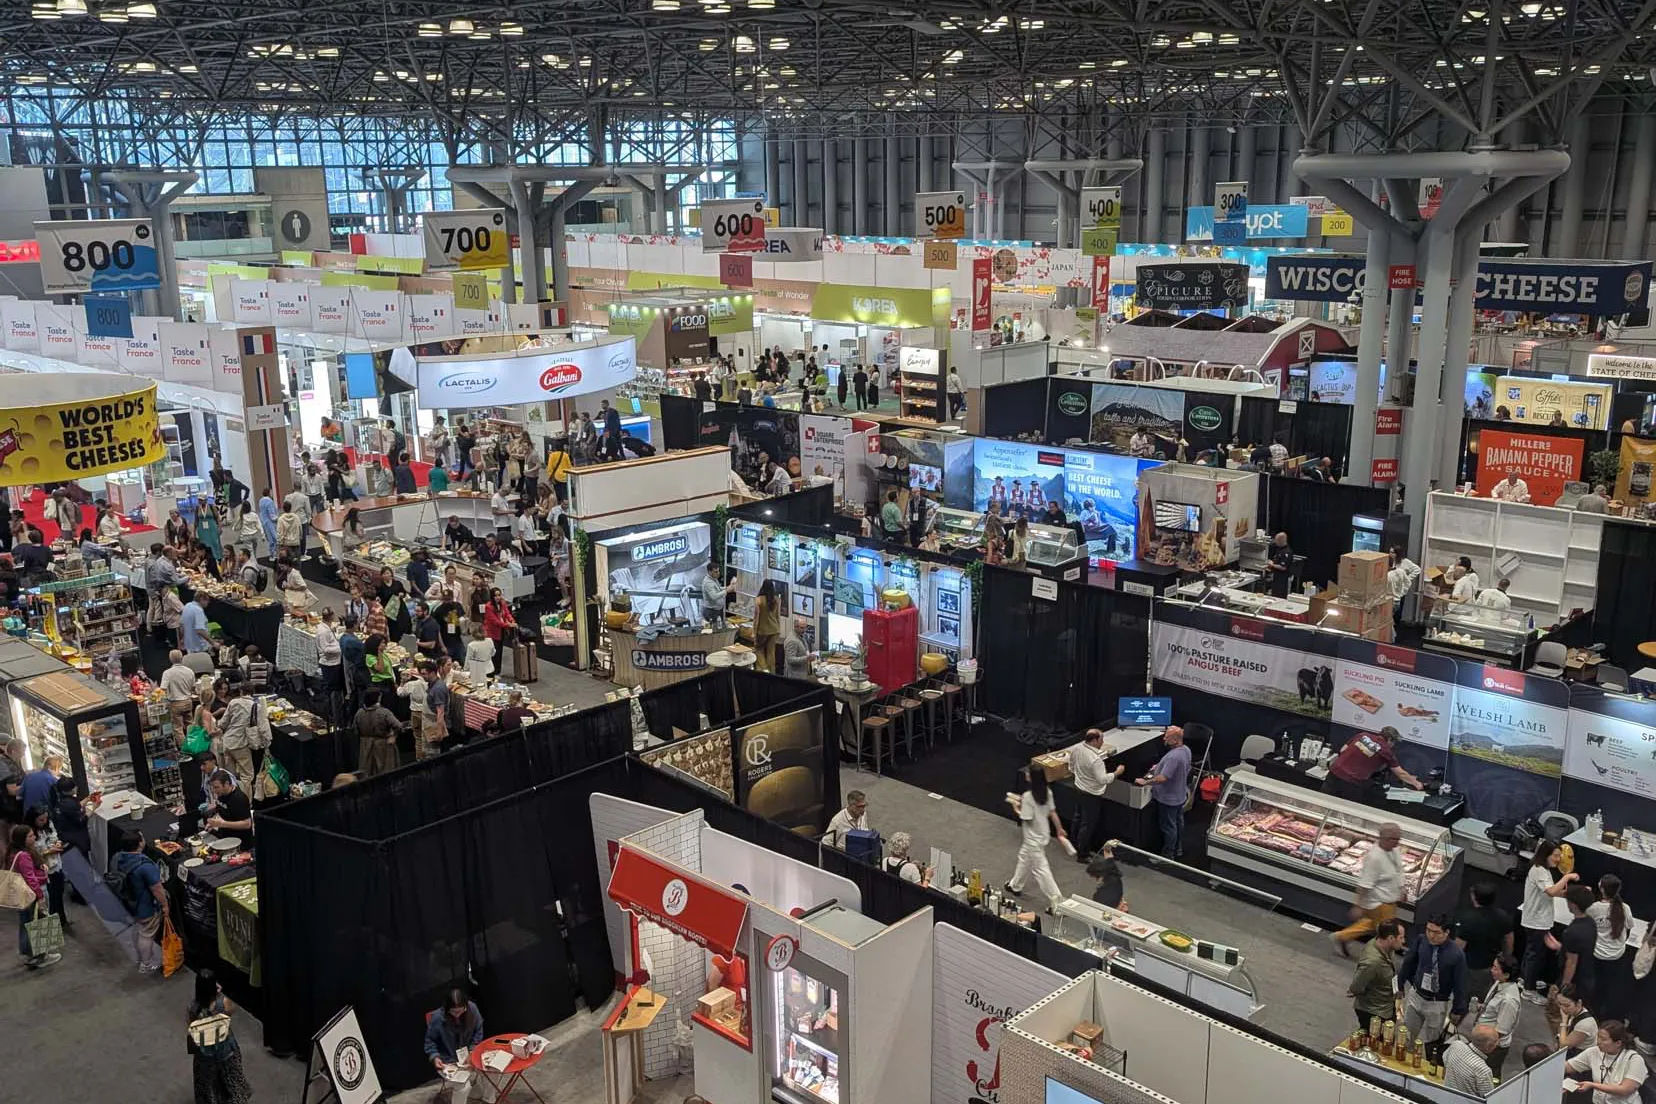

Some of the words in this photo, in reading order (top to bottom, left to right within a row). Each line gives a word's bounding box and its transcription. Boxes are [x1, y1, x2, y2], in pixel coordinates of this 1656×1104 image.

[1424, 184, 1438, 198] 100
[1220, 193, 1241, 210] 300
[1089, 199, 1113, 217] 400
[925, 205, 956, 226] 500
[714, 213, 753, 237] 600
[1329, 222, 1346, 230] 200
[441, 226, 491, 254] 700
[1091, 239, 1108, 249] 400
[62, 240, 136, 272] 800
[932, 250, 949, 261] 500
[728, 264, 745, 277] 600
[462, 284, 480, 299] 700
[1475, 272, 1599, 303] CHEESE
[319, 305, 337, 313] Taste
[853, 298, 898, 313] KOREA
[97, 309, 120, 325] 800
[362, 318, 386, 326] France
[410, 315, 430, 323] Taste
[680, 315, 706, 327] FOOD
[46, 327, 67, 335] Taste
[463, 321, 483, 329] Taste
[11, 329, 36, 337] France
[47, 335, 73, 343] France
[84, 342, 111, 350] France
[125, 340, 148, 348] Taste
[126, 349, 154, 357] France
[171, 347, 195, 356] Taste
[172, 357, 201, 365] France
[1605, 358, 1632, 368] Welcome
[1642, 361, 1653, 369] the
[1591, 368, 1616, 376] STATE
[444, 378, 491, 387] LACTALIS
[543, 370, 579, 387] Galbani
[1316, 384, 1338, 392] CACTUS
[59, 397, 144, 428] WORLD'S
[1122, 414, 1136, 423] and
[63, 425, 114, 449] BEST
[65, 438, 145, 470] CHEESES
[1486, 447, 1528, 466] BANANA
[1532, 452, 1573, 474] PEPPER
[1505, 465, 1550, 477] SAUCE
[1068, 473, 1085, 483] BEST
[1087, 475, 1112, 487] CHEESE
[1068, 485, 1076, 493] IN
[1078, 486, 1092, 495] THE
[1094, 488, 1122, 499] WORLD.
[645, 538, 685, 556] AMBROSI
[648, 653, 705, 666] AMBROSI
[1167, 643, 1190, 656] 100%
[1191, 648, 1230, 665] PASTURE
[1233, 658, 1267, 673] RAISED
[1187, 658, 1219, 672] ANGUS
[1221, 666, 1241, 677] BEEF
[1344, 669, 1373, 681] SUCKLING
[1394, 681, 1426, 692] SUCKLING
[1427, 688, 1444, 696] LAMB
[1456, 702, 1502, 723] WELSH
[1508, 715, 1546, 733] LAMB
[1642, 732, 1656, 742] SP
[747, 764, 773, 776] ROGERS
